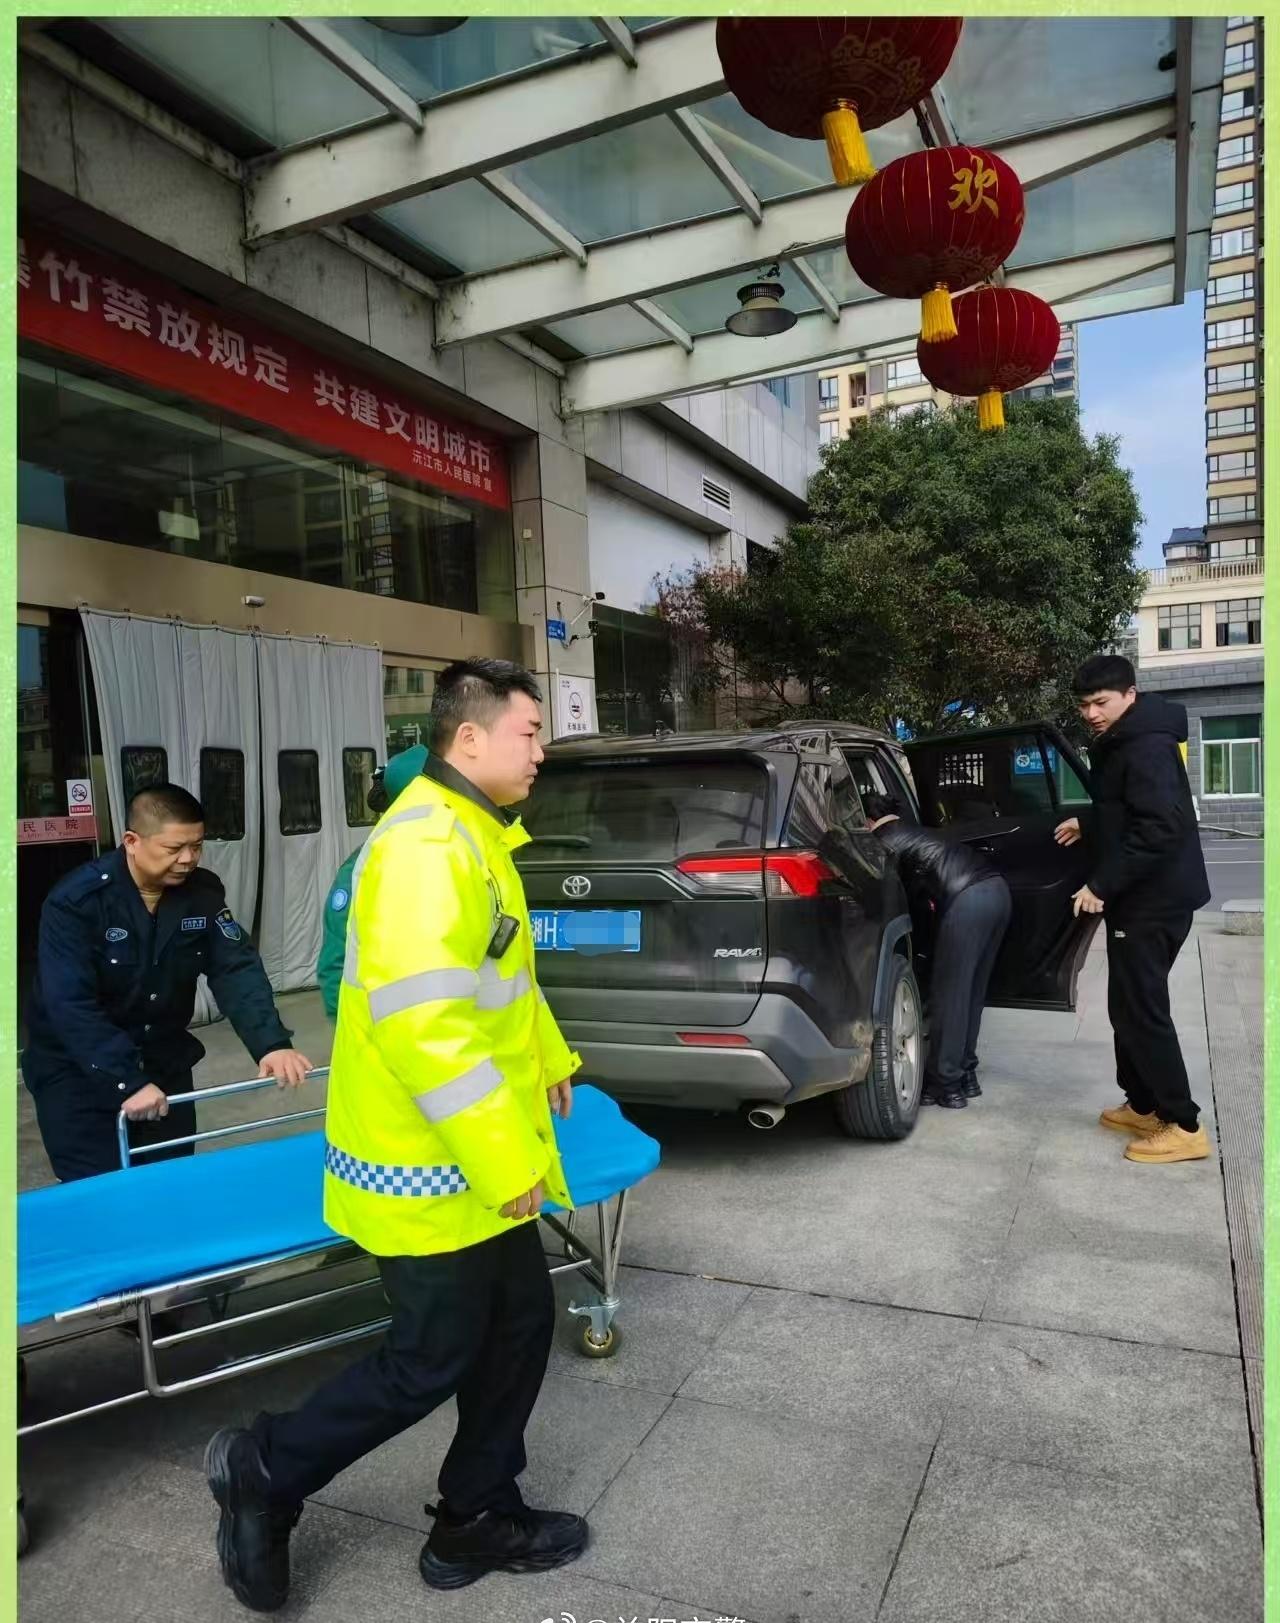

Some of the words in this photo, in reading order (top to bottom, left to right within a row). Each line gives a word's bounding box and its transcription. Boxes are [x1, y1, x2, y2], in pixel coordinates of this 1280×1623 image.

[17, 239, 290, 393] 竹禁放规定
[314, 368, 491, 473] 共建文明城市
[412, 449, 481, 488] 沅江市人民医院
[713, 947, 762, 958] RAV4
